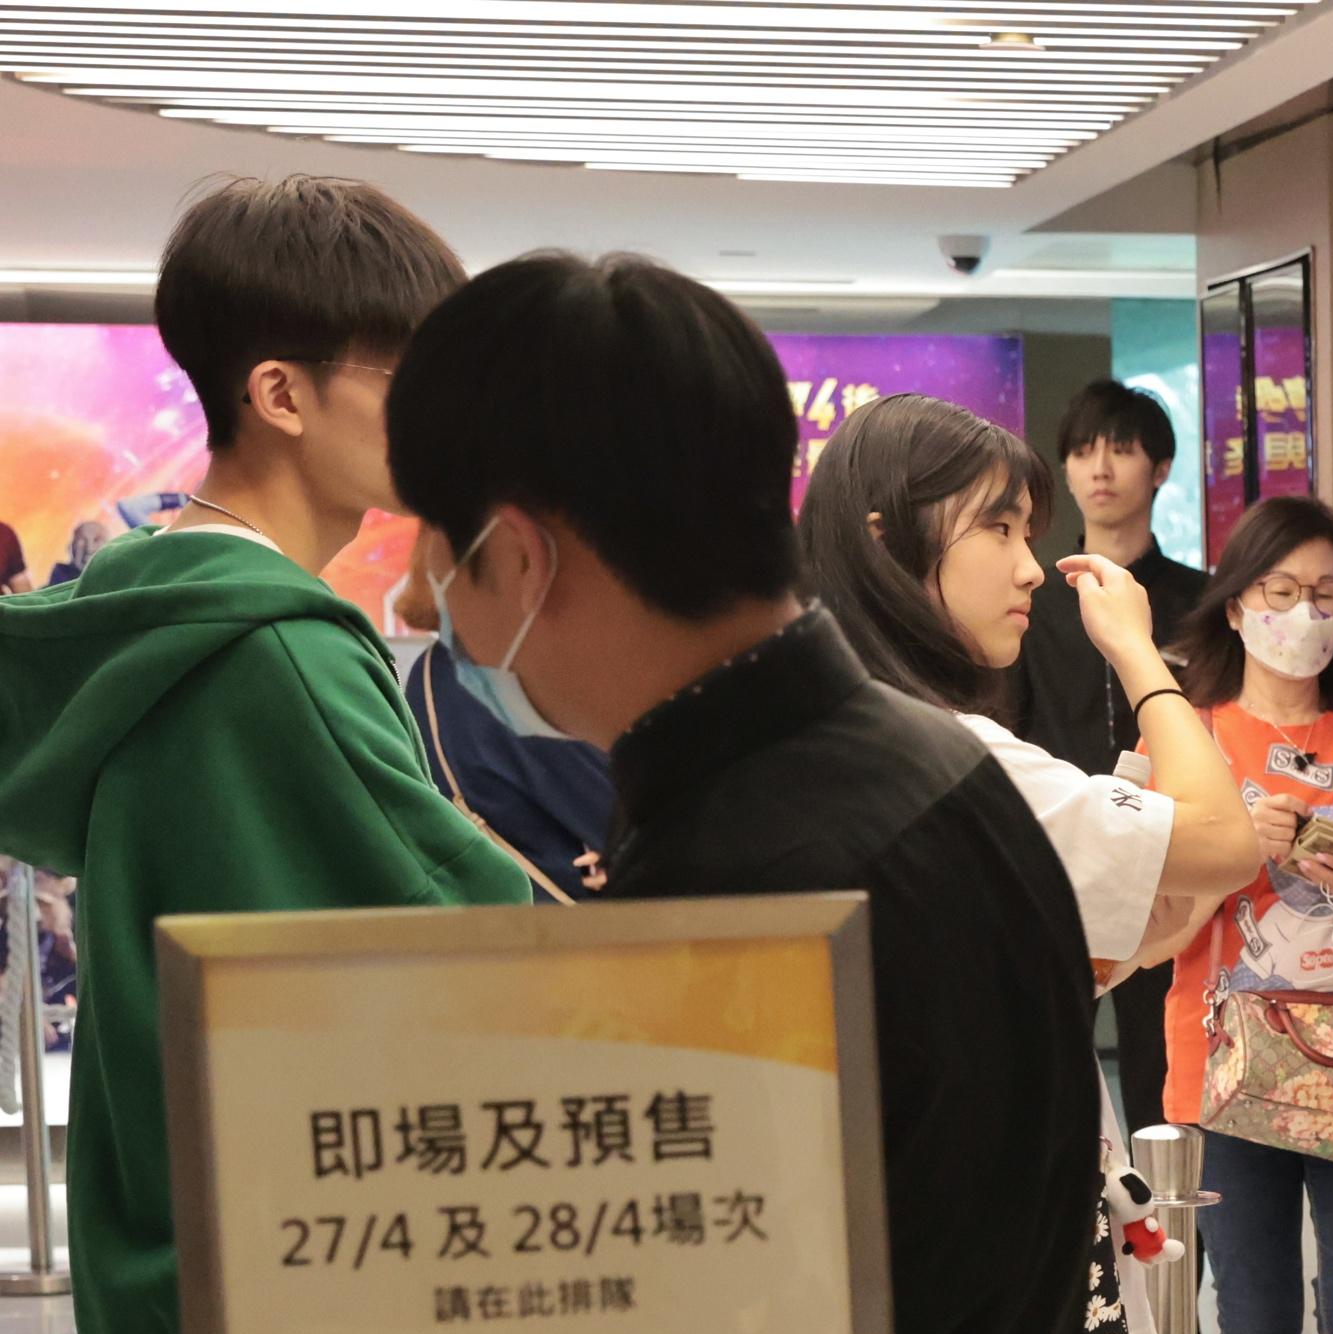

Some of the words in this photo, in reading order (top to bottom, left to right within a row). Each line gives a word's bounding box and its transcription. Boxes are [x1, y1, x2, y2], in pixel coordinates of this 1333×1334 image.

[309, 1089, 715, 1180] 即場及預售
[281, 1213, 415, 1269] 27/4
[438, 1204, 491, 1260] 及
[434, 1276, 637, 1324] 請在此排隊
